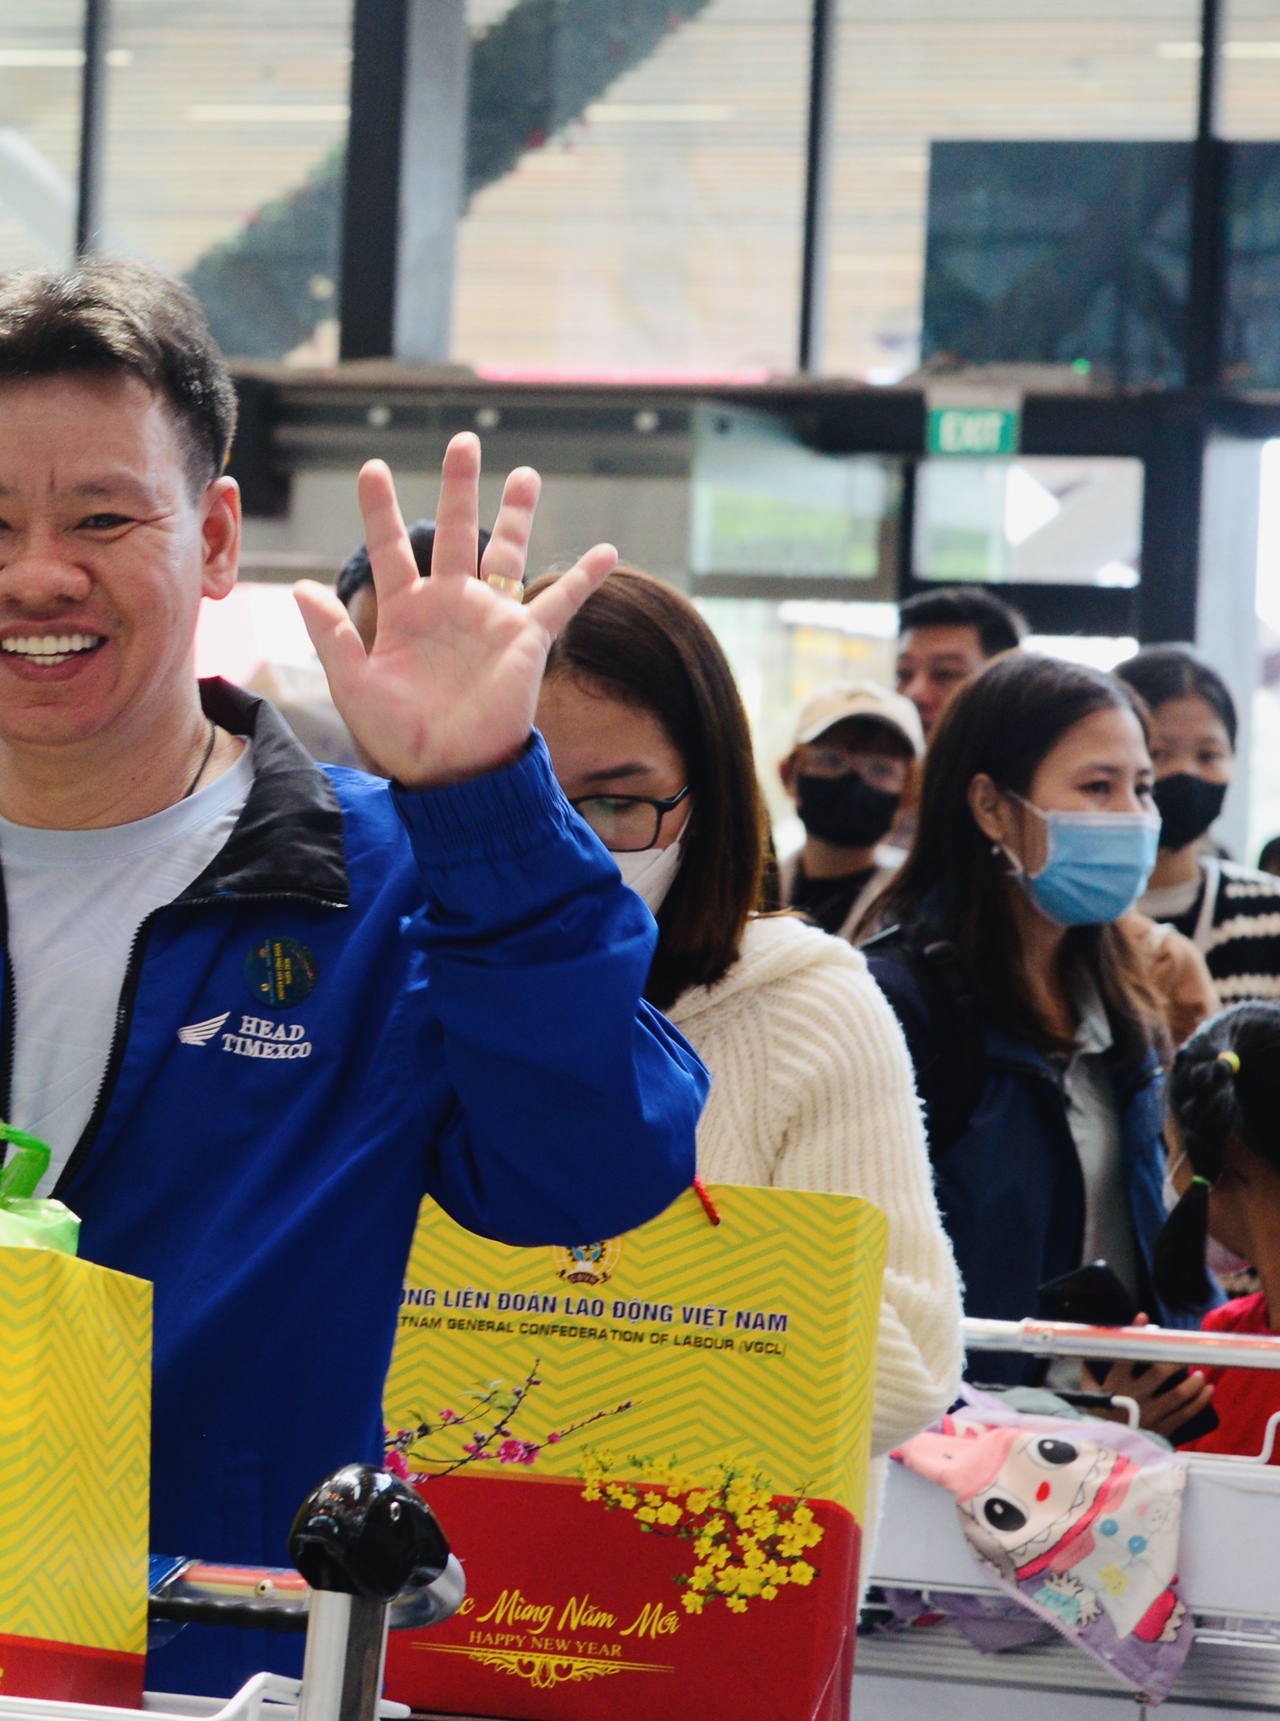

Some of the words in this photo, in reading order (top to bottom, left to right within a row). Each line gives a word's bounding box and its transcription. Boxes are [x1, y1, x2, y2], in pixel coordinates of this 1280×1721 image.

[939, 411, 1005, 452] EXIT
[222, 1033, 312, 1059] TIMEXCO
[239, 1015, 305, 1041] HEAD
[444, 1287, 490, 1310] LIÊN
[498, 1290, 557, 1314] ĐOÀN
[565, 1297, 605, 1318] LAO
[612, 1298, 673, 1325] ĐỘNG
[682, 1304, 728, 1331] VIỆT
[736, 1311, 788, 1332] NAM
[398, 1315, 442, 1329] TNAM
[447, 1318, 514, 1334] GENERAL
[519, 1323, 644, 1343] CONFEDERATION
[650, 1332, 669, 1345] OF
[674, 1334, 734, 1350] LABOUR
[739, 1340, 787, 1357] (VGCL)
[557, 1593, 618, 1632] Năm
[619, 1601, 681, 1639] Mới
[469, 1631, 525, 1648] HAPPY
[530, 1636, 571, 1652] NEW
[575, 1640, 623, 1657] YEAR
